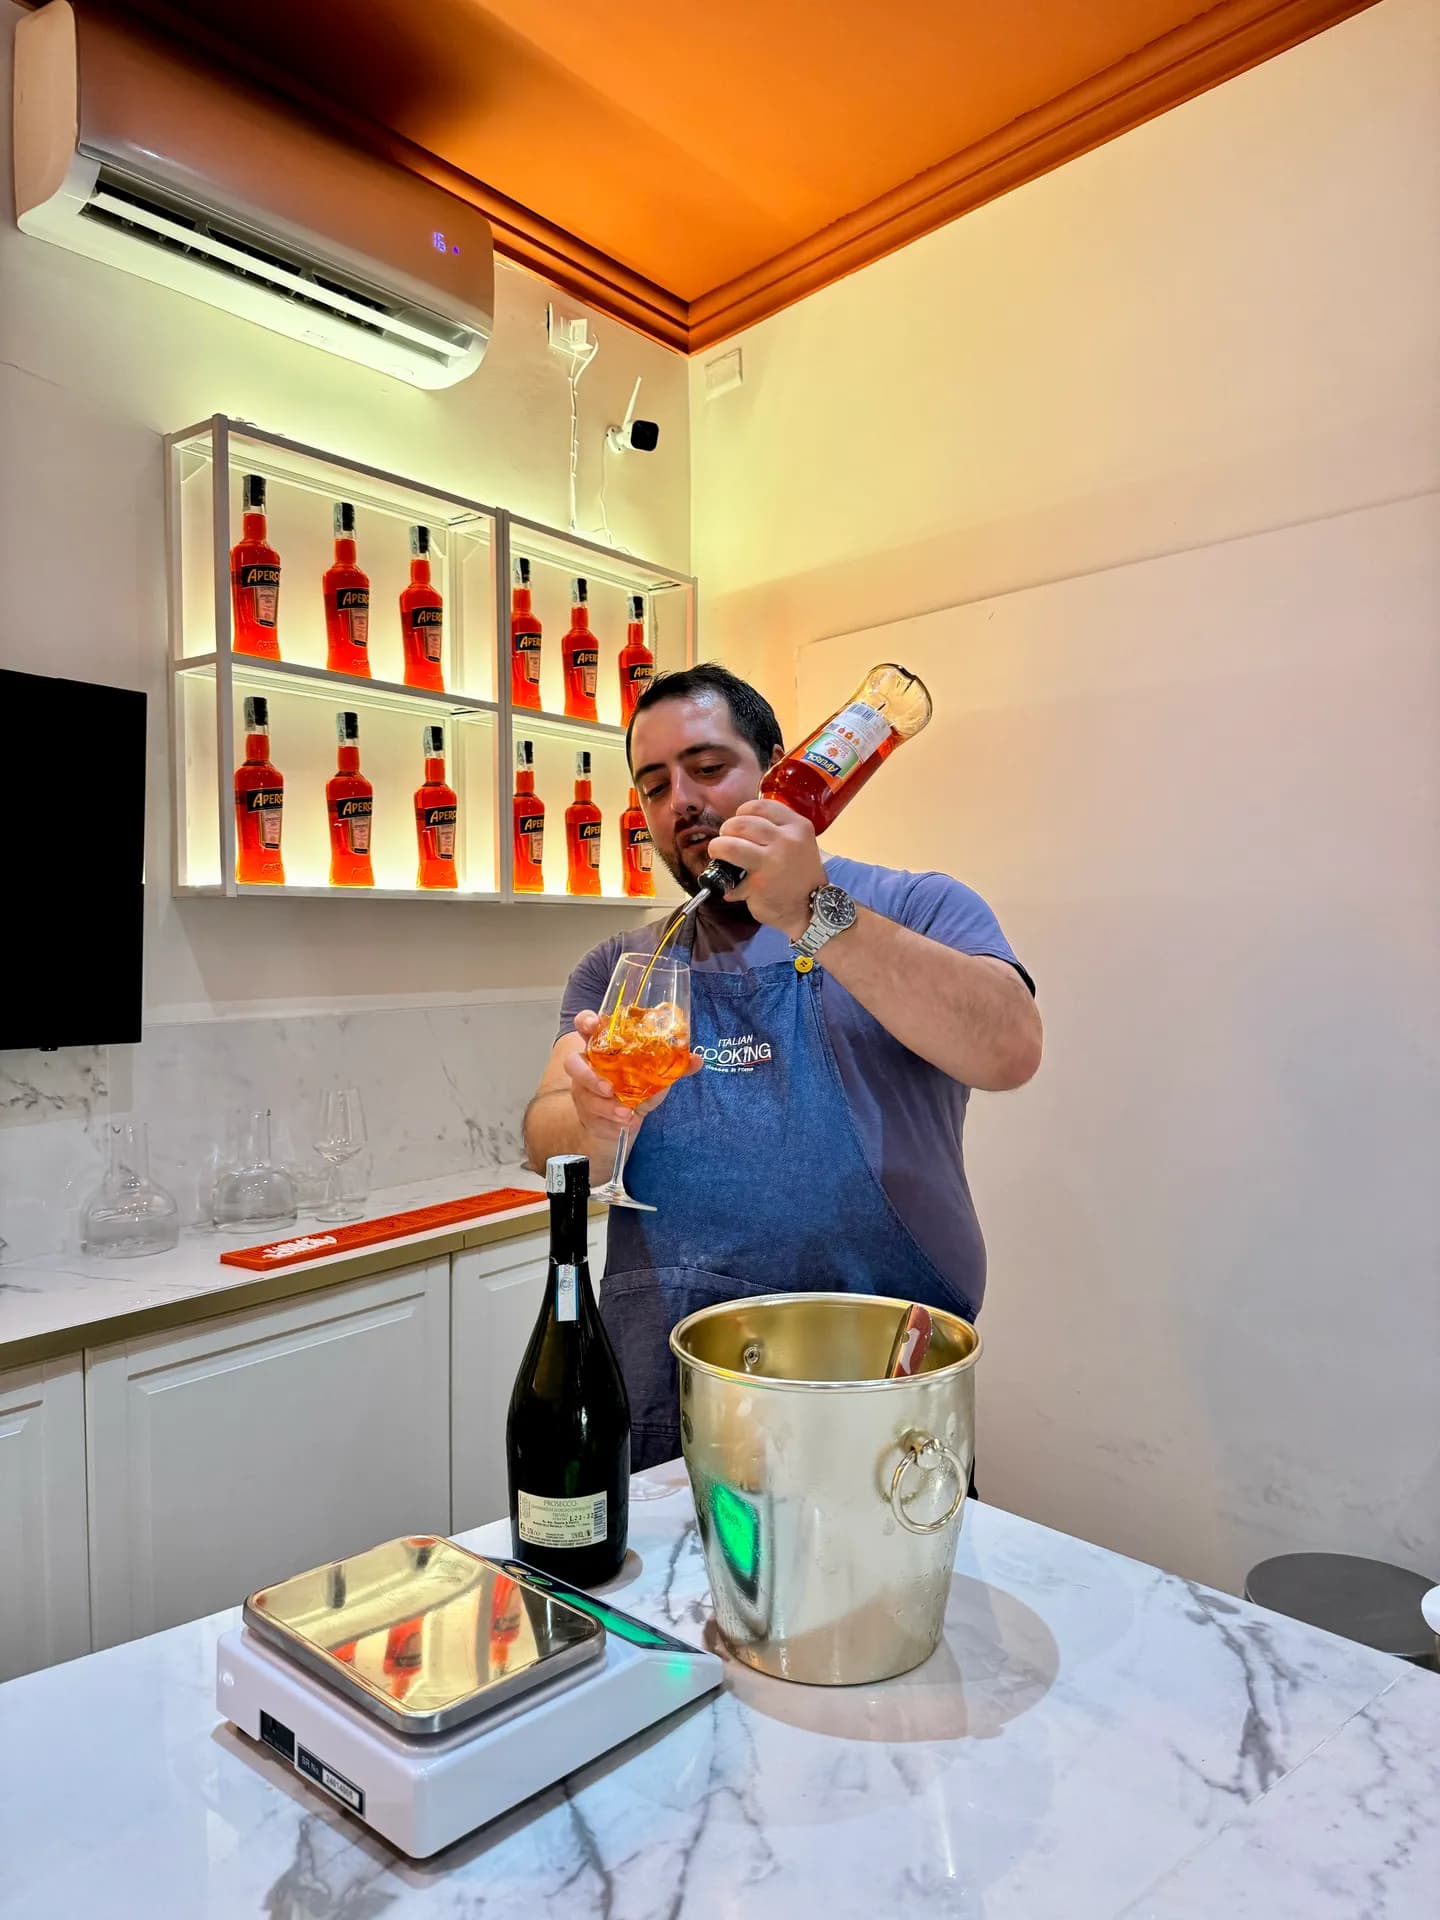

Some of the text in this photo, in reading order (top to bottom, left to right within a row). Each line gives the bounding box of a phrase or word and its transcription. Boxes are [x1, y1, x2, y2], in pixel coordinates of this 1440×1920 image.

[807, 754, 839, 773] APEROL
[718, 1034, 753, 1047] ITALIAN
[693, 1043, 772, 1064] COOKING
